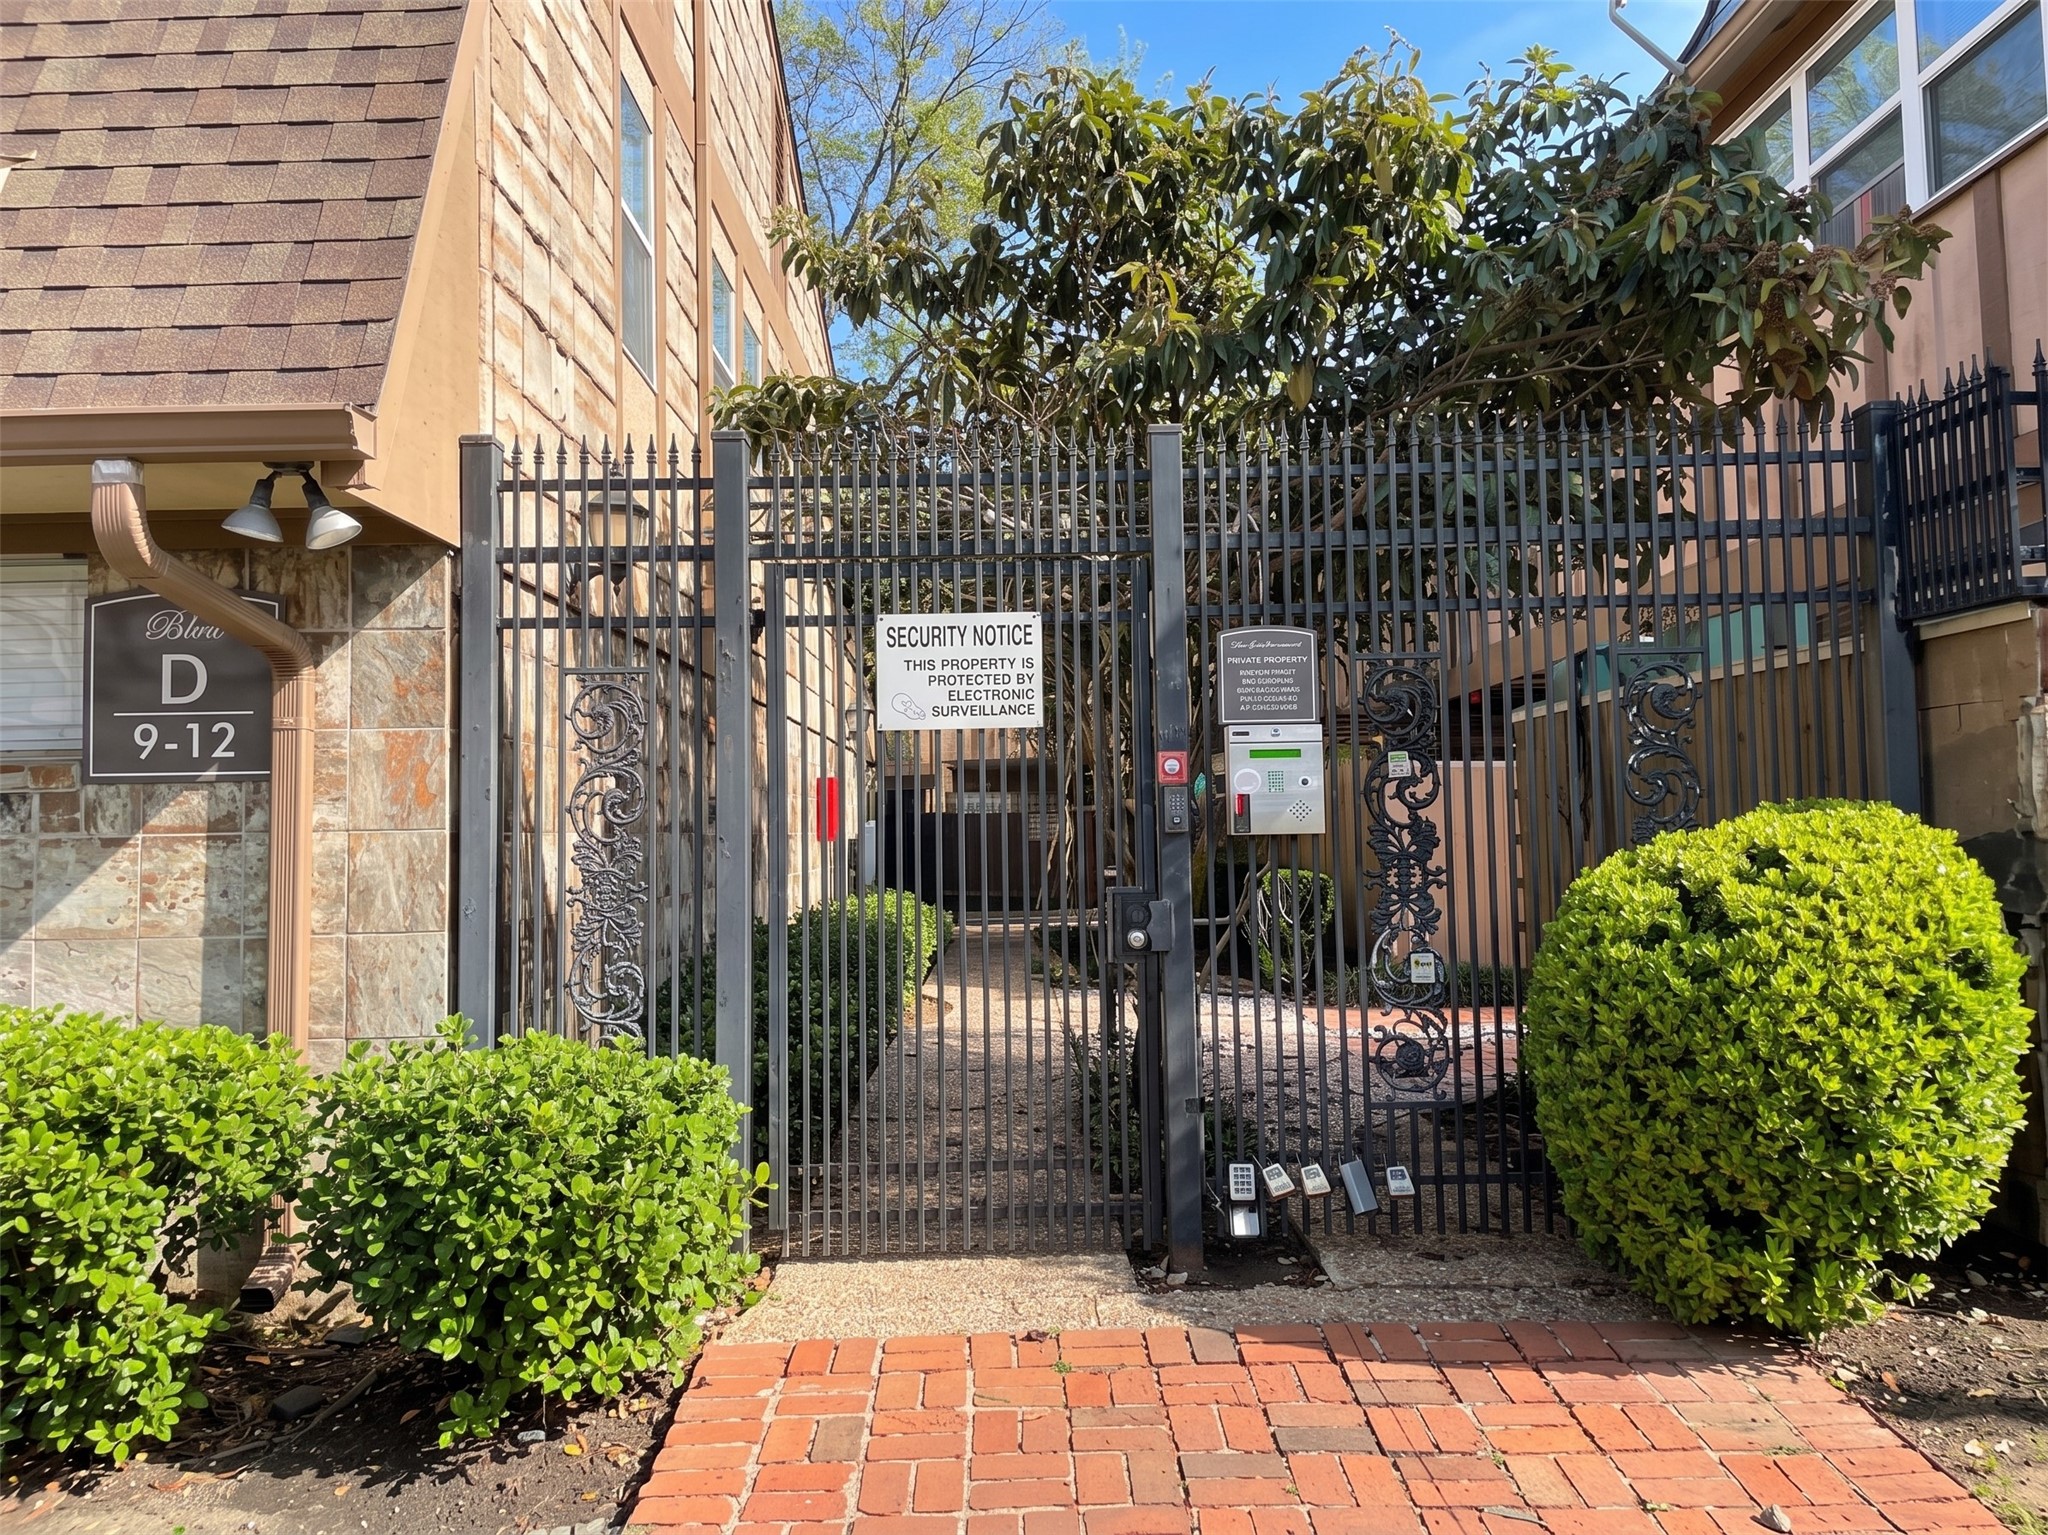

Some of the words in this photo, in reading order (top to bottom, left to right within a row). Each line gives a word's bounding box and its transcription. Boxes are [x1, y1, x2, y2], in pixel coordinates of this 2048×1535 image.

[886, 625, 968, 648] SECURITY
[973, 624, 1033, 647] NOTICE
[904, 659, 936, 671] THIS
[941, 658, 1016, 671] PROPERTY
[1022, 657, 1035, 669] IS
[162, 654, 208, 705] D
[928, 673, 1011, 686] PROTECTED
[1016, 673, 1035, 685] BY
[948, 688, 1035, 701] ELECTRONIC
[931, 703, 1035, 717] SURVEILLANCE
[133, 721, 236, 760] 9-12
